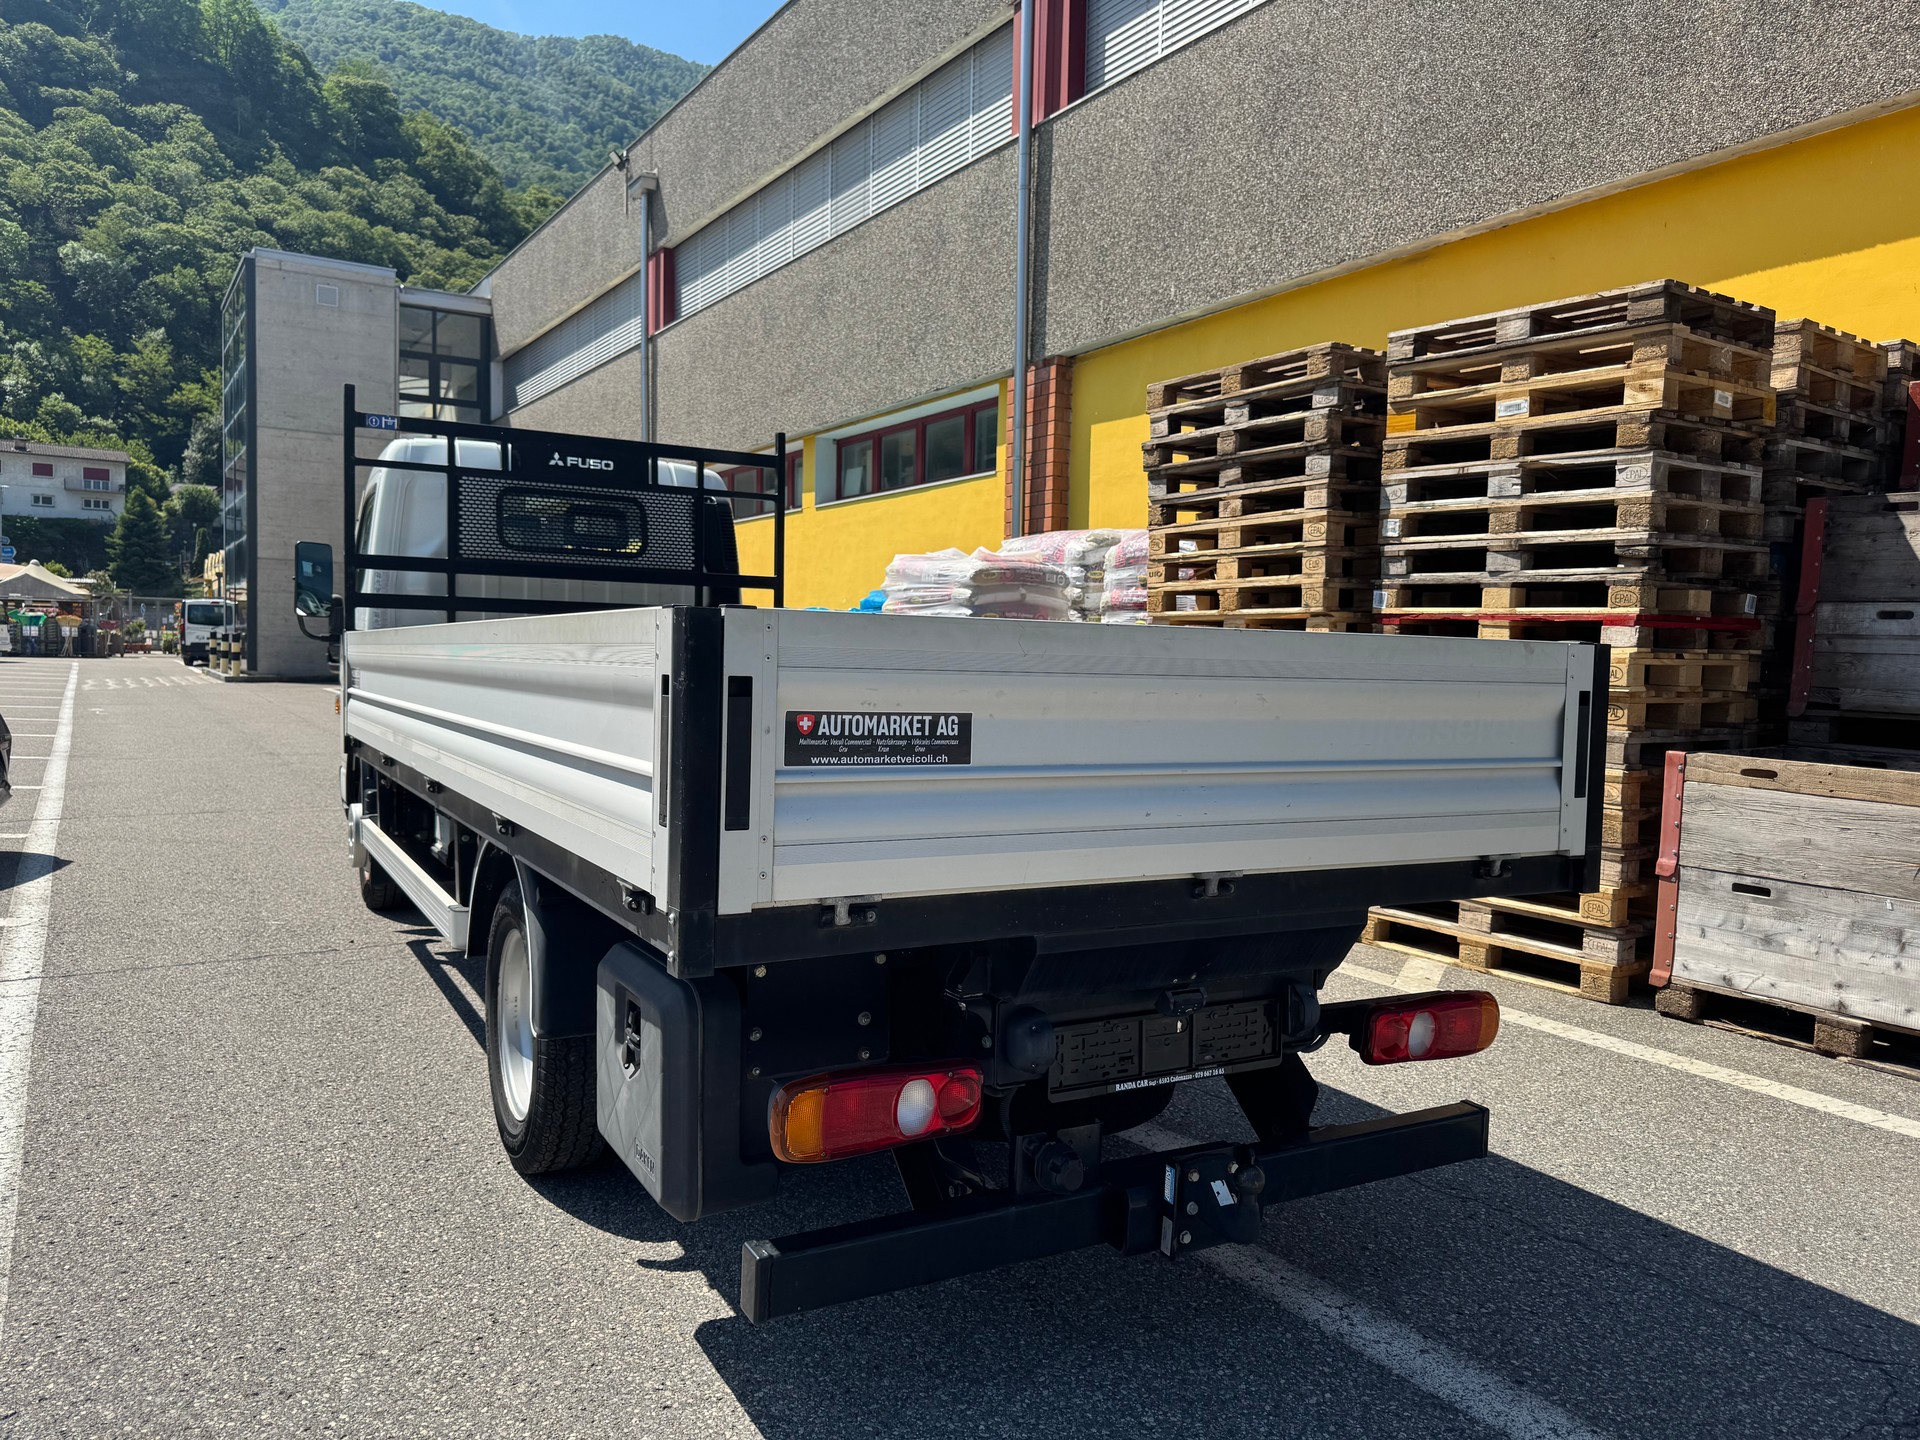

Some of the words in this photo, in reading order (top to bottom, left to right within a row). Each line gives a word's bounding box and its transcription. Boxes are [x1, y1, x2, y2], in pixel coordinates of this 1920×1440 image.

[567, 456, 614, 471] FUSO
[1625, 469, 1644, 480] EPAL
[1614, 594, 1634, 604] EPAL
[817, 714, 932, 736] AUTOMARKET
[936, 715, 959, 736] AG
[810, 754, 948, 764] www.automarketveicoli.ch
[1587, 902, 1606, 915] EPAL
[1115, 1081, 1136, 1092] RANDA
[1136, 1079, 1149, 1089] CAR
